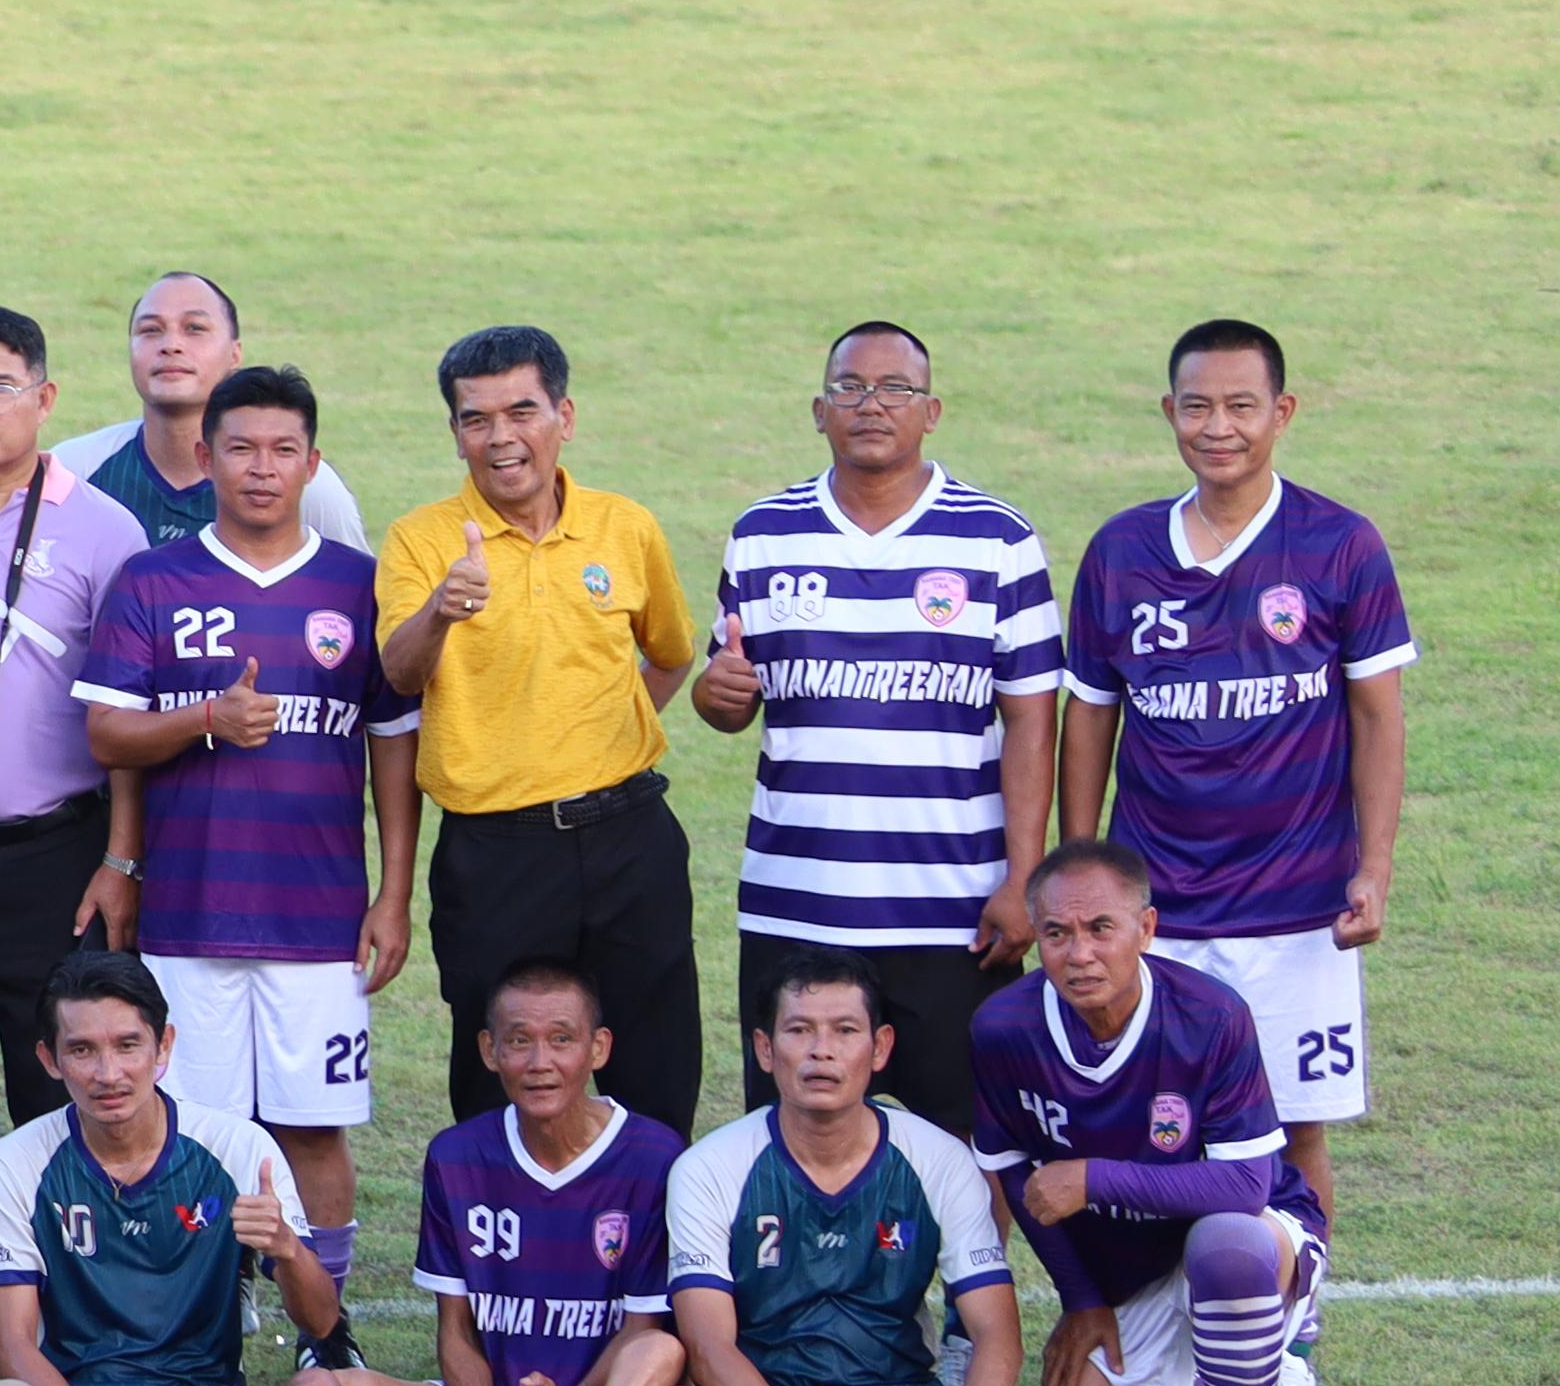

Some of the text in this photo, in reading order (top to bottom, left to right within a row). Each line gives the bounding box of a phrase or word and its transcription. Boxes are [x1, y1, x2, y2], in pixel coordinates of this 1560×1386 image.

[767, 570, 829, 623] 88
[172, 604, 237, 660] 22
[1131, 598, 1189, 655] 25
[277, 694, 320, 735] REE
[1217, 675, 1285, 722] TREE
[325, 1028, 369, 1085] 22
[1297, 1022, 1355, 1083] 25
[1019, 1088, 1073, 1149] 42
[466, 1203, 521, 1261] 99
[755, 1213, 783, 1270] 2
[469, 1291, 534, 1340] NANA
[542, 1296, 604, 1341] TREE
